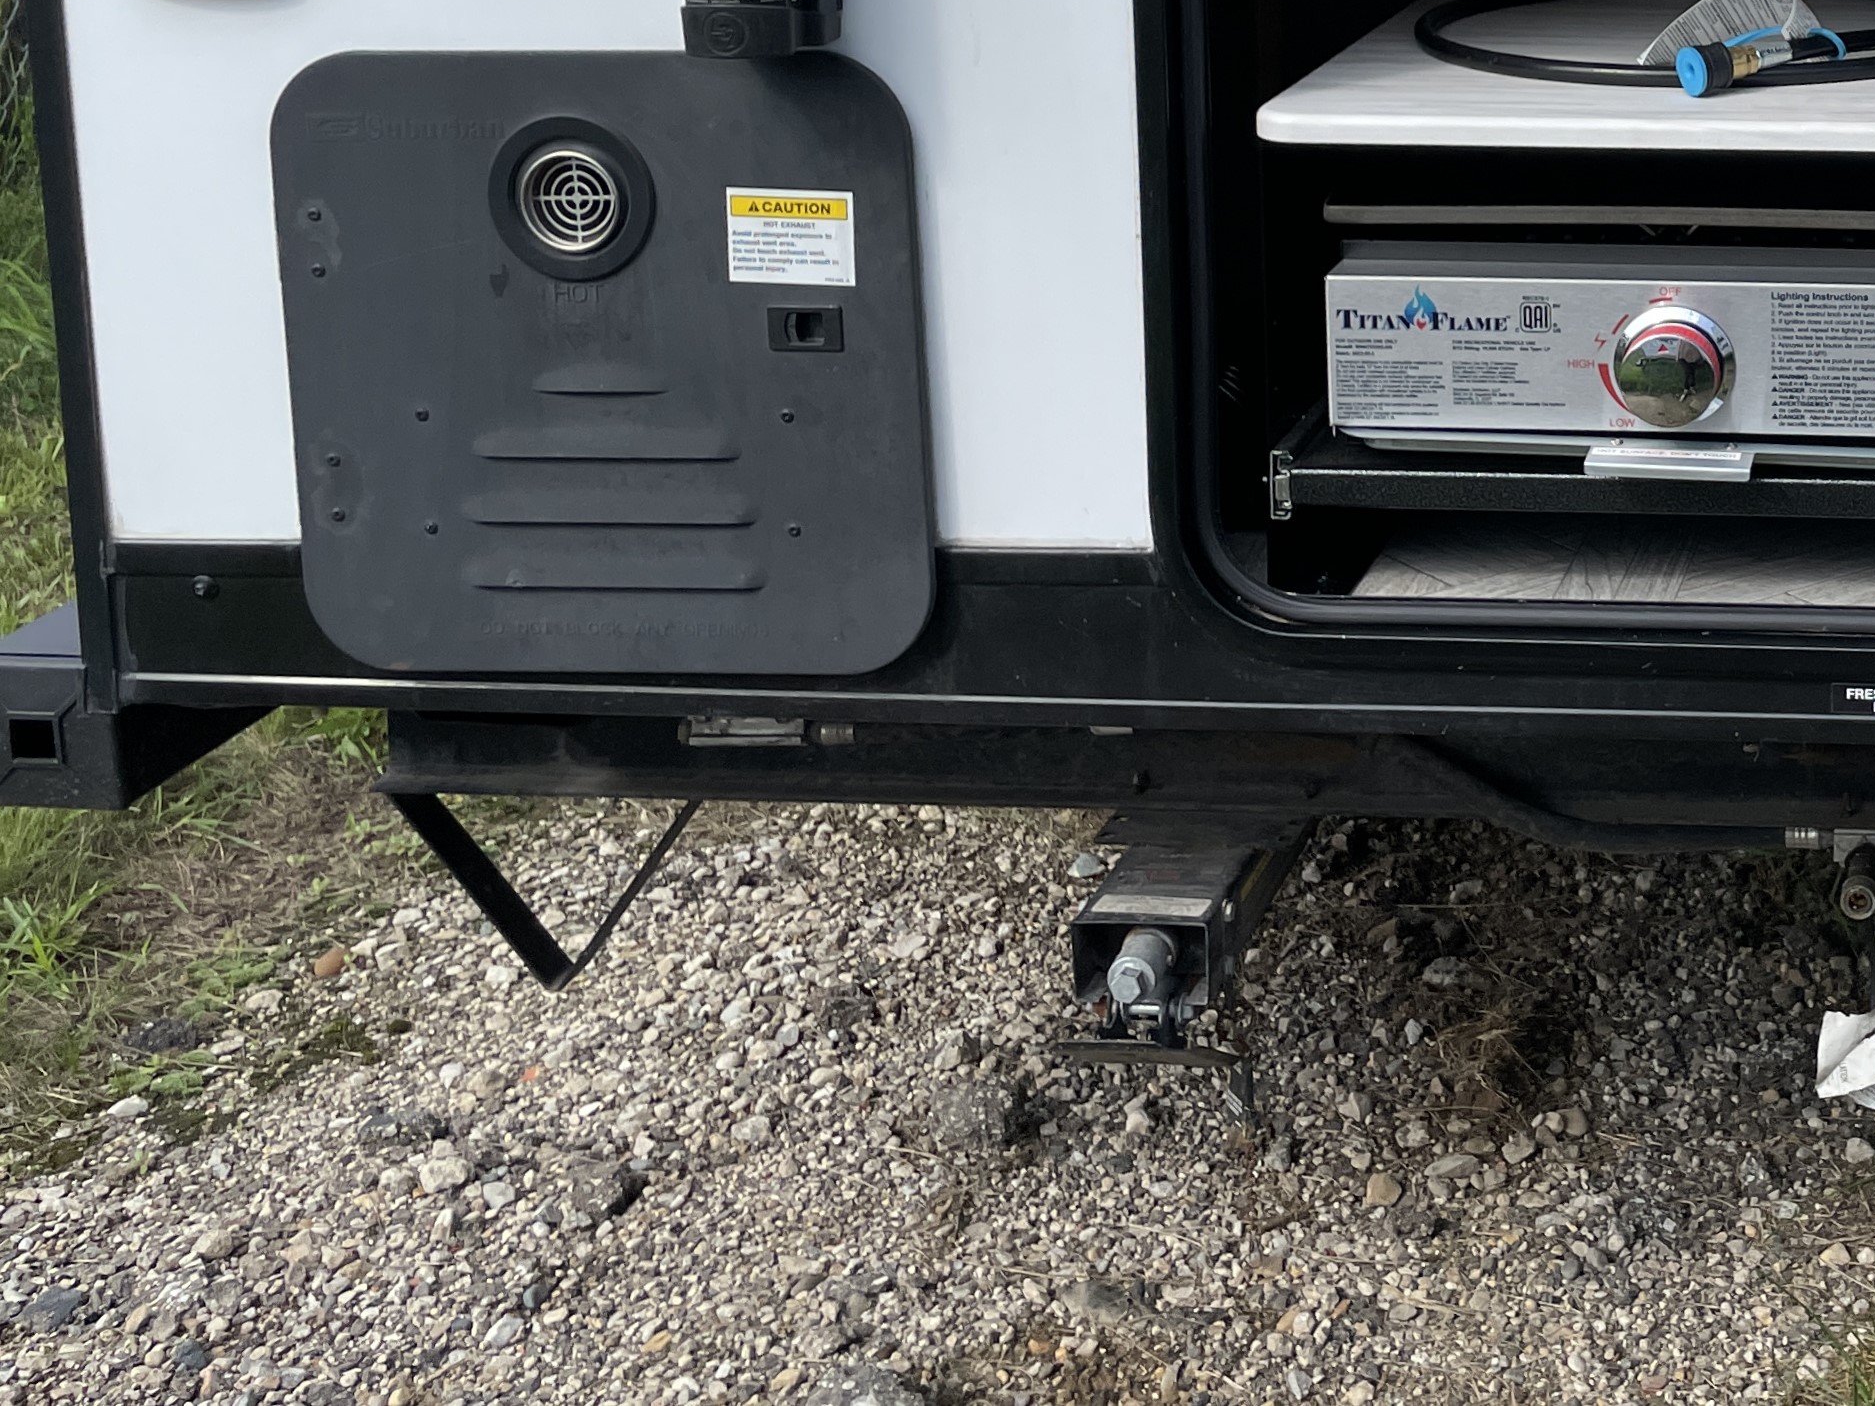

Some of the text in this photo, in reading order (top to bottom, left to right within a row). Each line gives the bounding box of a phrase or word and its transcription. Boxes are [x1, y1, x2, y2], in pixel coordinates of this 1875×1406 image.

[762, 202, 830, 214] CAUTION
[554, 284, 604, 303] HOT
[1660, 287, 1681, 296] OFF
[1771, 292, 1868, 302] Lighting Instructions
[1336, 309, 1507, 332] TITAN FLAME
[1524, 306, 1548, 329] QAI
[1568, 360, 1594, 368] HIGH
[1610, 419, 1634, 427] LOW
